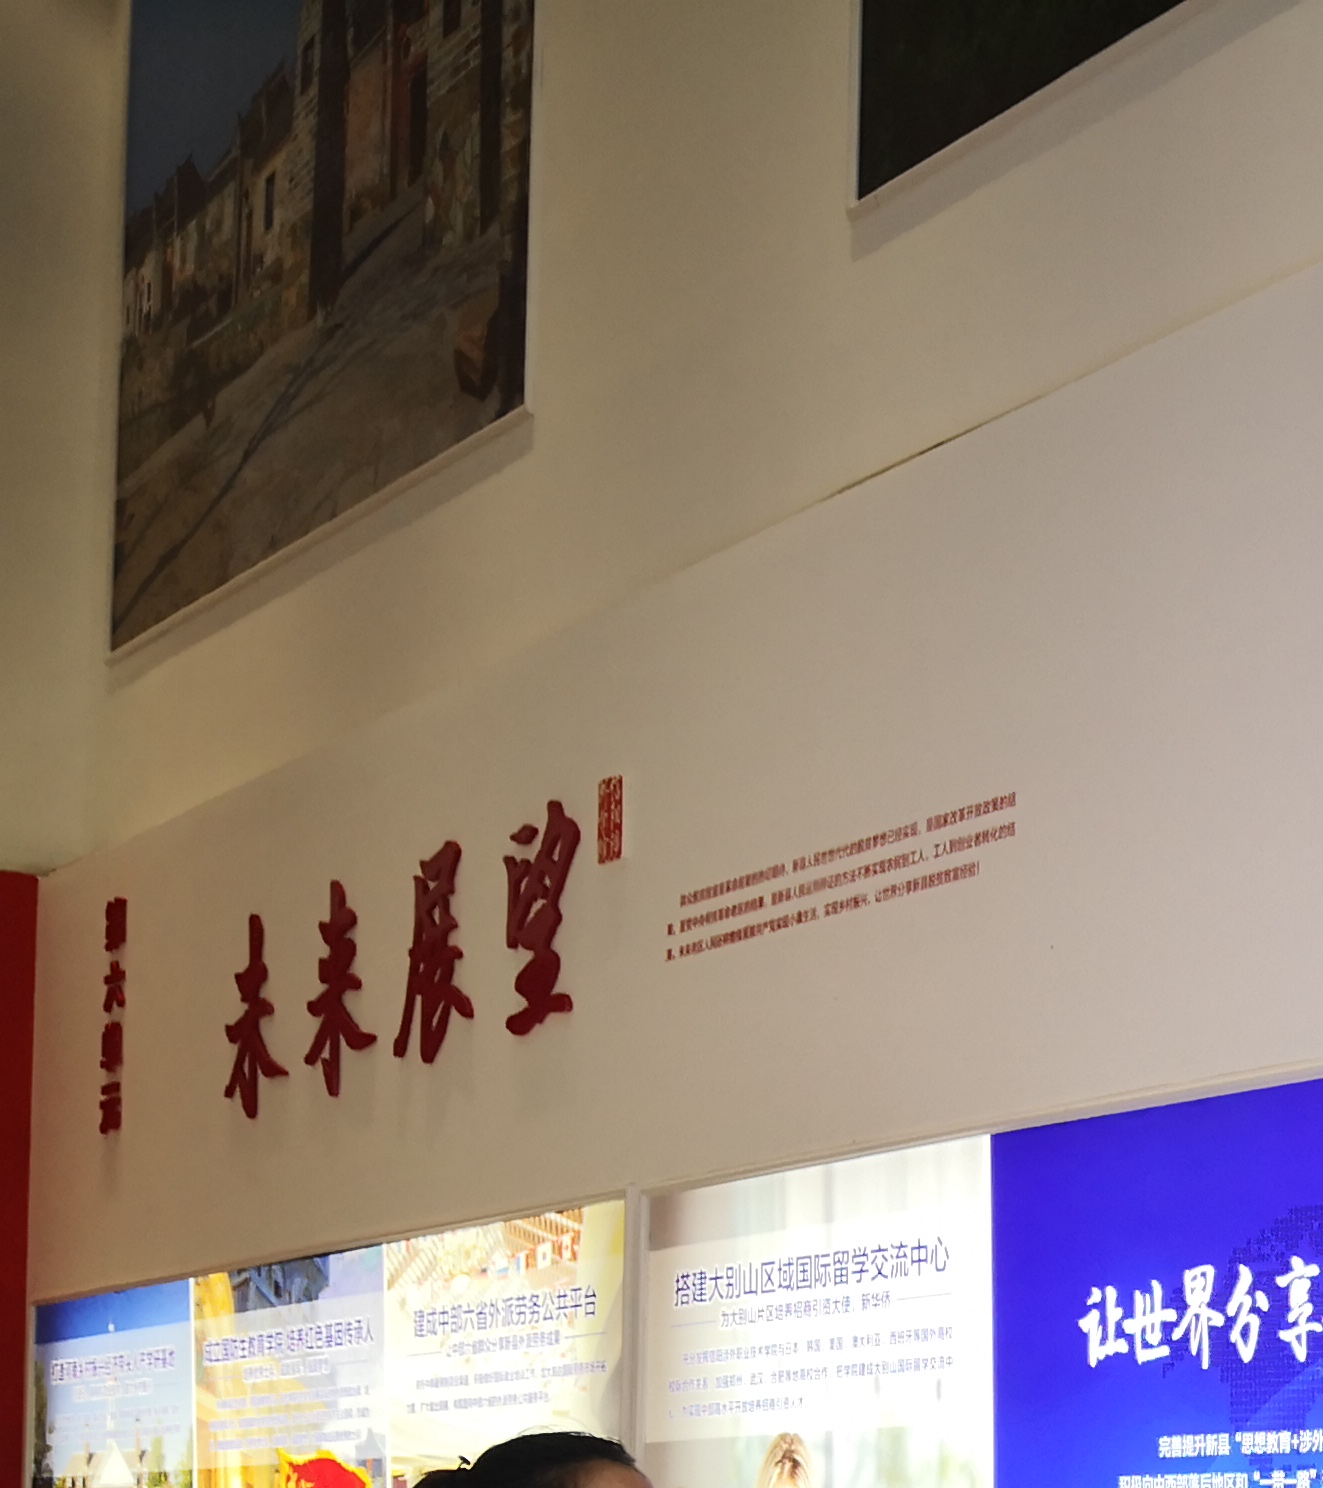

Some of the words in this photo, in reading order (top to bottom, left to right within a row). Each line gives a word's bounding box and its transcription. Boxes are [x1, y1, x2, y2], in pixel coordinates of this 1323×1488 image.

[224, 800, 580, 1119] 未来展望
[674, 1236, 949, 1307] 搭建大别山区域国际留学交流中心
[413, 1285, 597, 1338] 建成中部六省外派劳务公共平台
